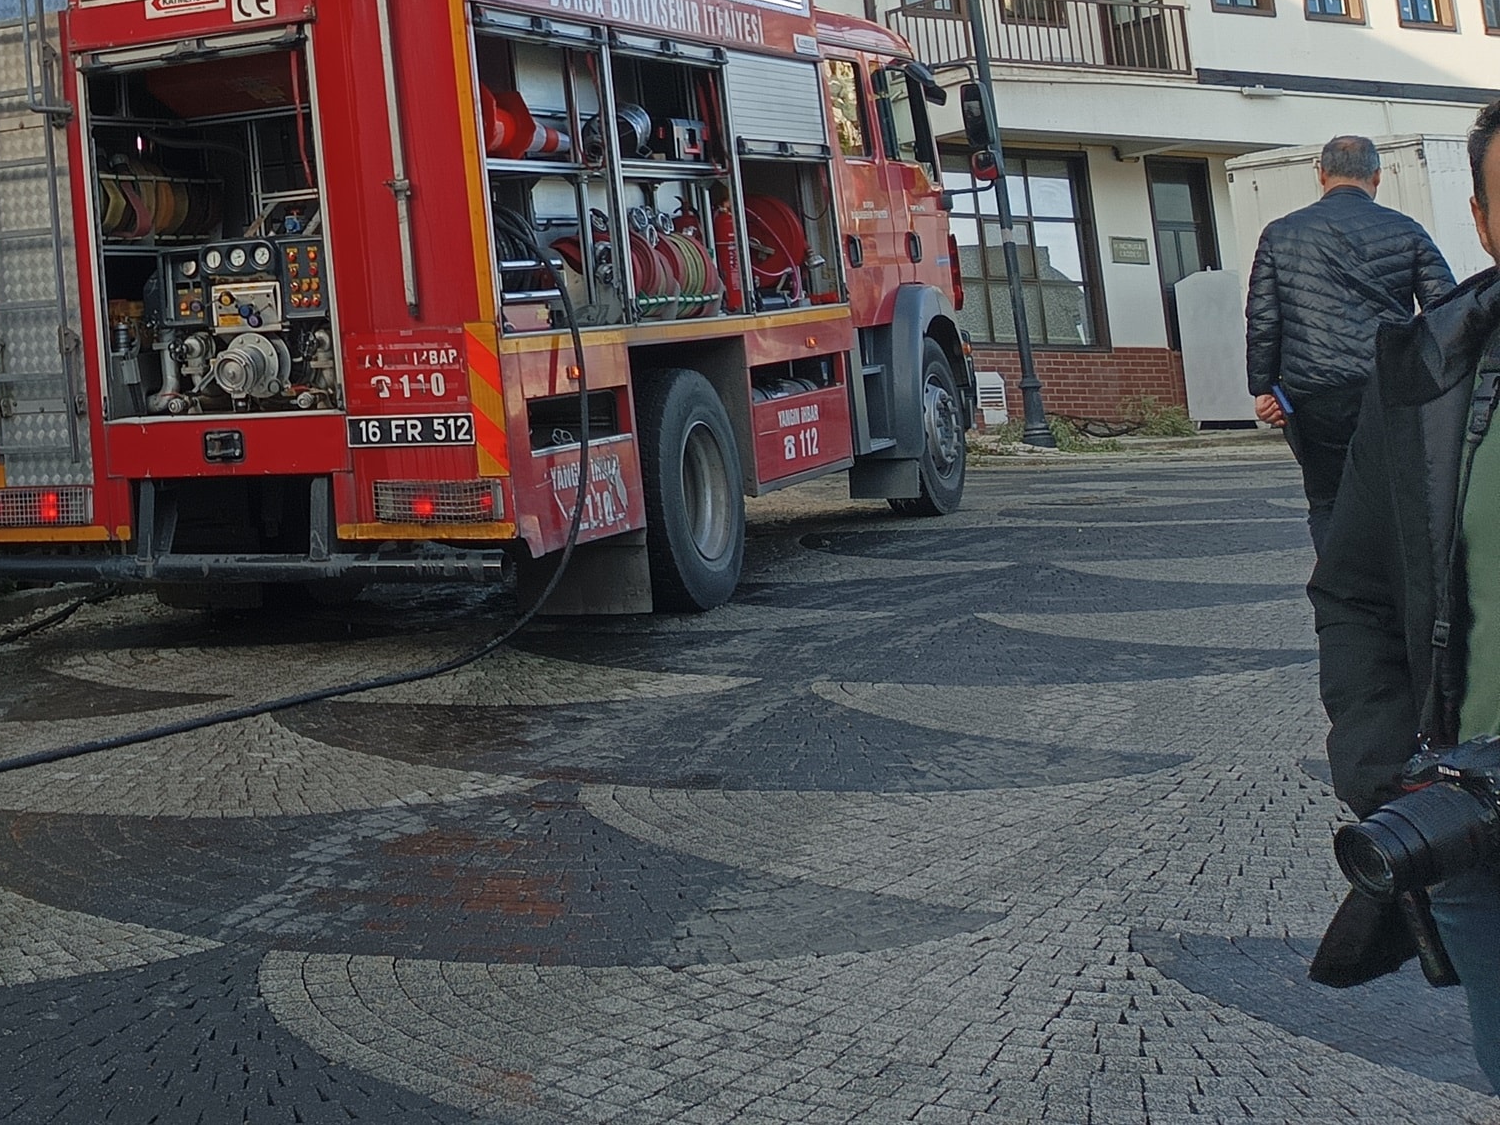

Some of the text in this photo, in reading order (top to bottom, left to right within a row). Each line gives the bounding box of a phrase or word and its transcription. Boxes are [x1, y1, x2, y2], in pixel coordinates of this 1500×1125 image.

[359, 418, 471, 443] 16 FR 512
[800, 427, 819, 457] 112
